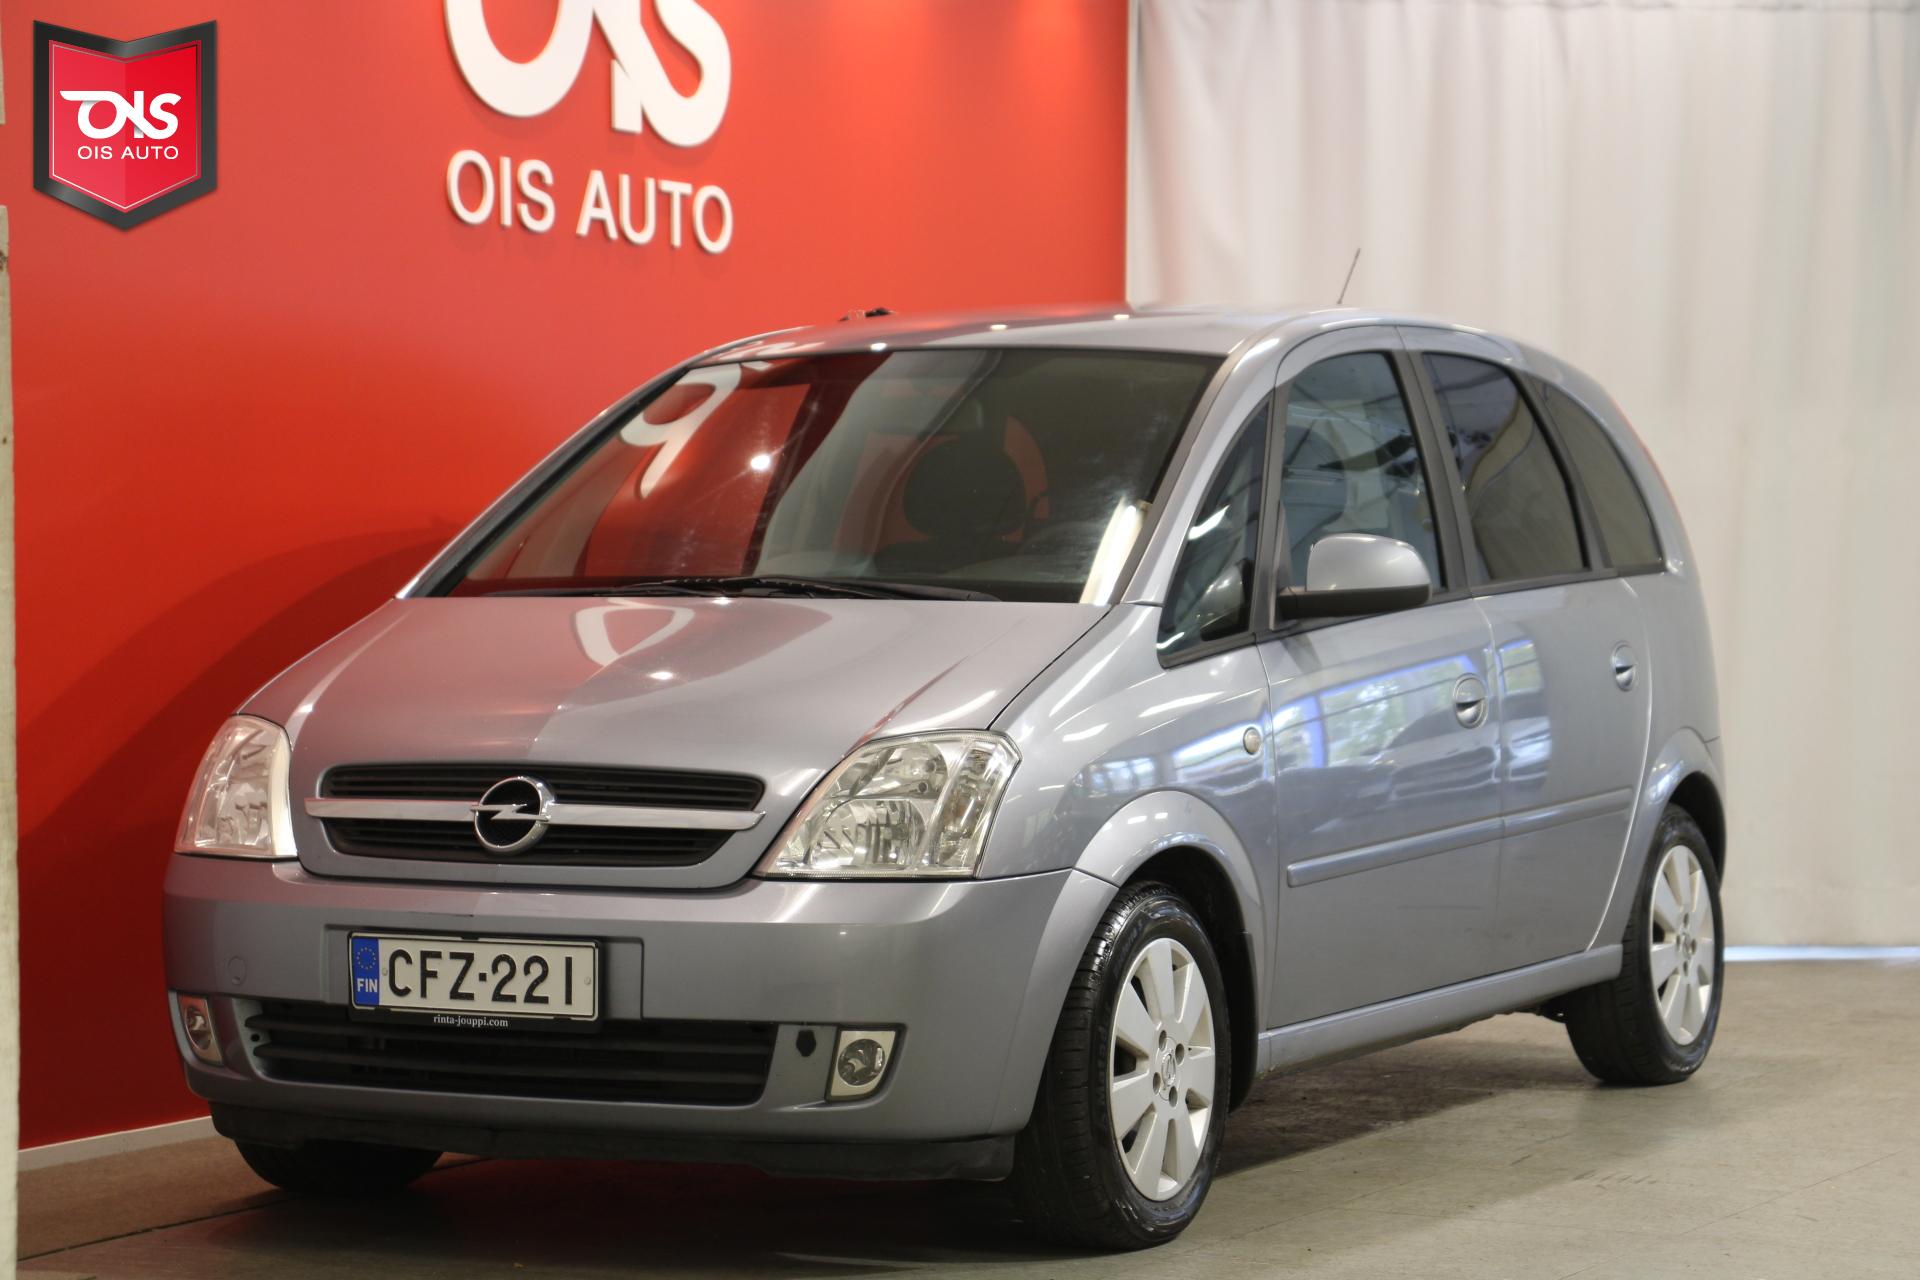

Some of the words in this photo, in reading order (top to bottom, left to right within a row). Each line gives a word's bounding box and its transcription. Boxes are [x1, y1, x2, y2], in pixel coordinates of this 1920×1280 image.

[446, 149, 556, 233] OIS
[575, 169, 733, 254] AUTO
[357, 978, 378, 993] FIN
[433, 1014, 509, 1029] rinta-jouppi.com
